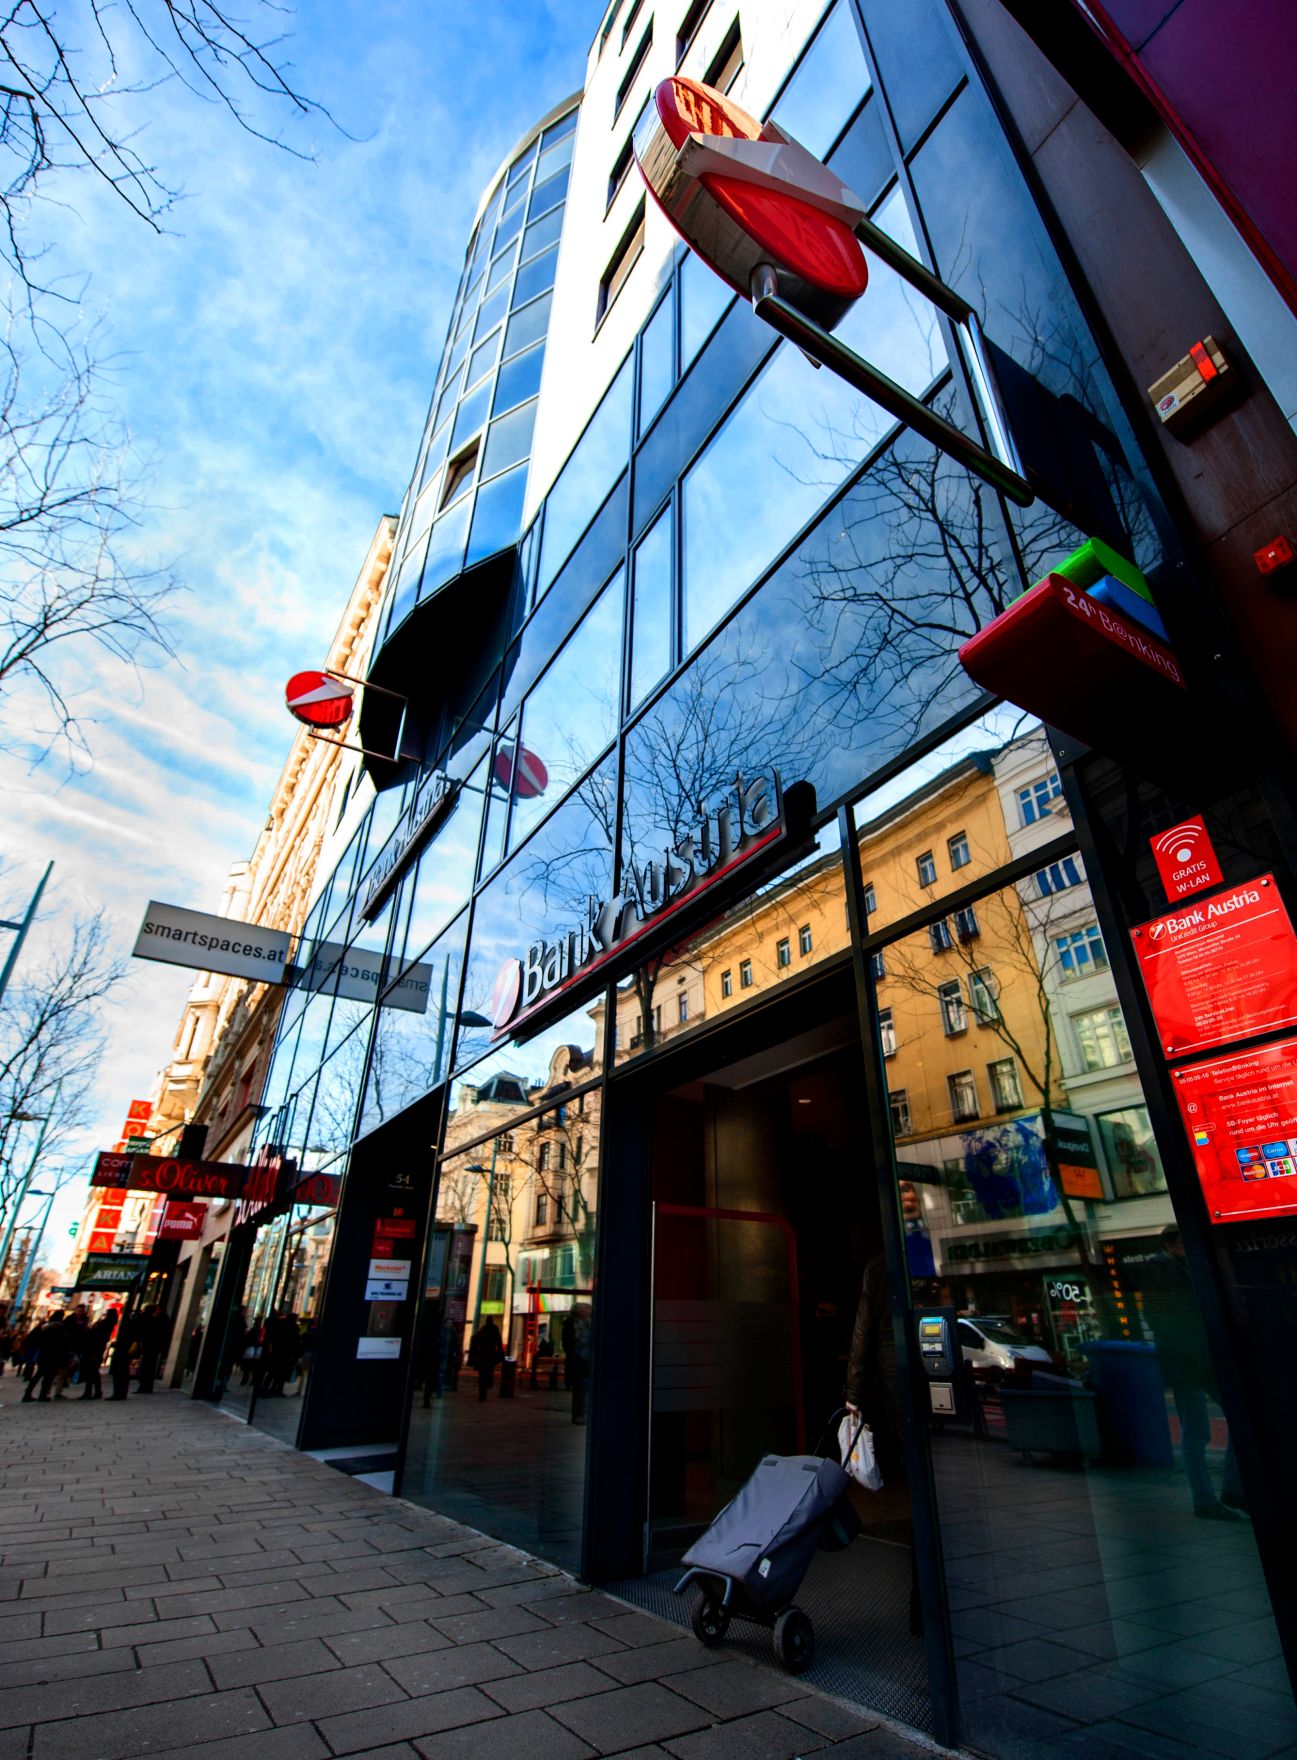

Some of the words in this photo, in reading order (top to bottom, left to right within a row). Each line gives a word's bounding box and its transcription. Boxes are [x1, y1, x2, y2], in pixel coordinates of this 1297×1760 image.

[522, 894, 604, 1006] Bank
[613, 767, 784, 925] Austria
[1172, 861, 1207, 882] GRATIS
[1176, 873, 1211, 893] W-LAN
[1166, 910, 1204, 933] Bank
[1206, 889, 1260, 920] Austria
[143, 920, 287, 964] smartspaces.at
[1229, 1128, 1244, 1136] rund
[1266, 1120, 1279, 1128] Uhr
